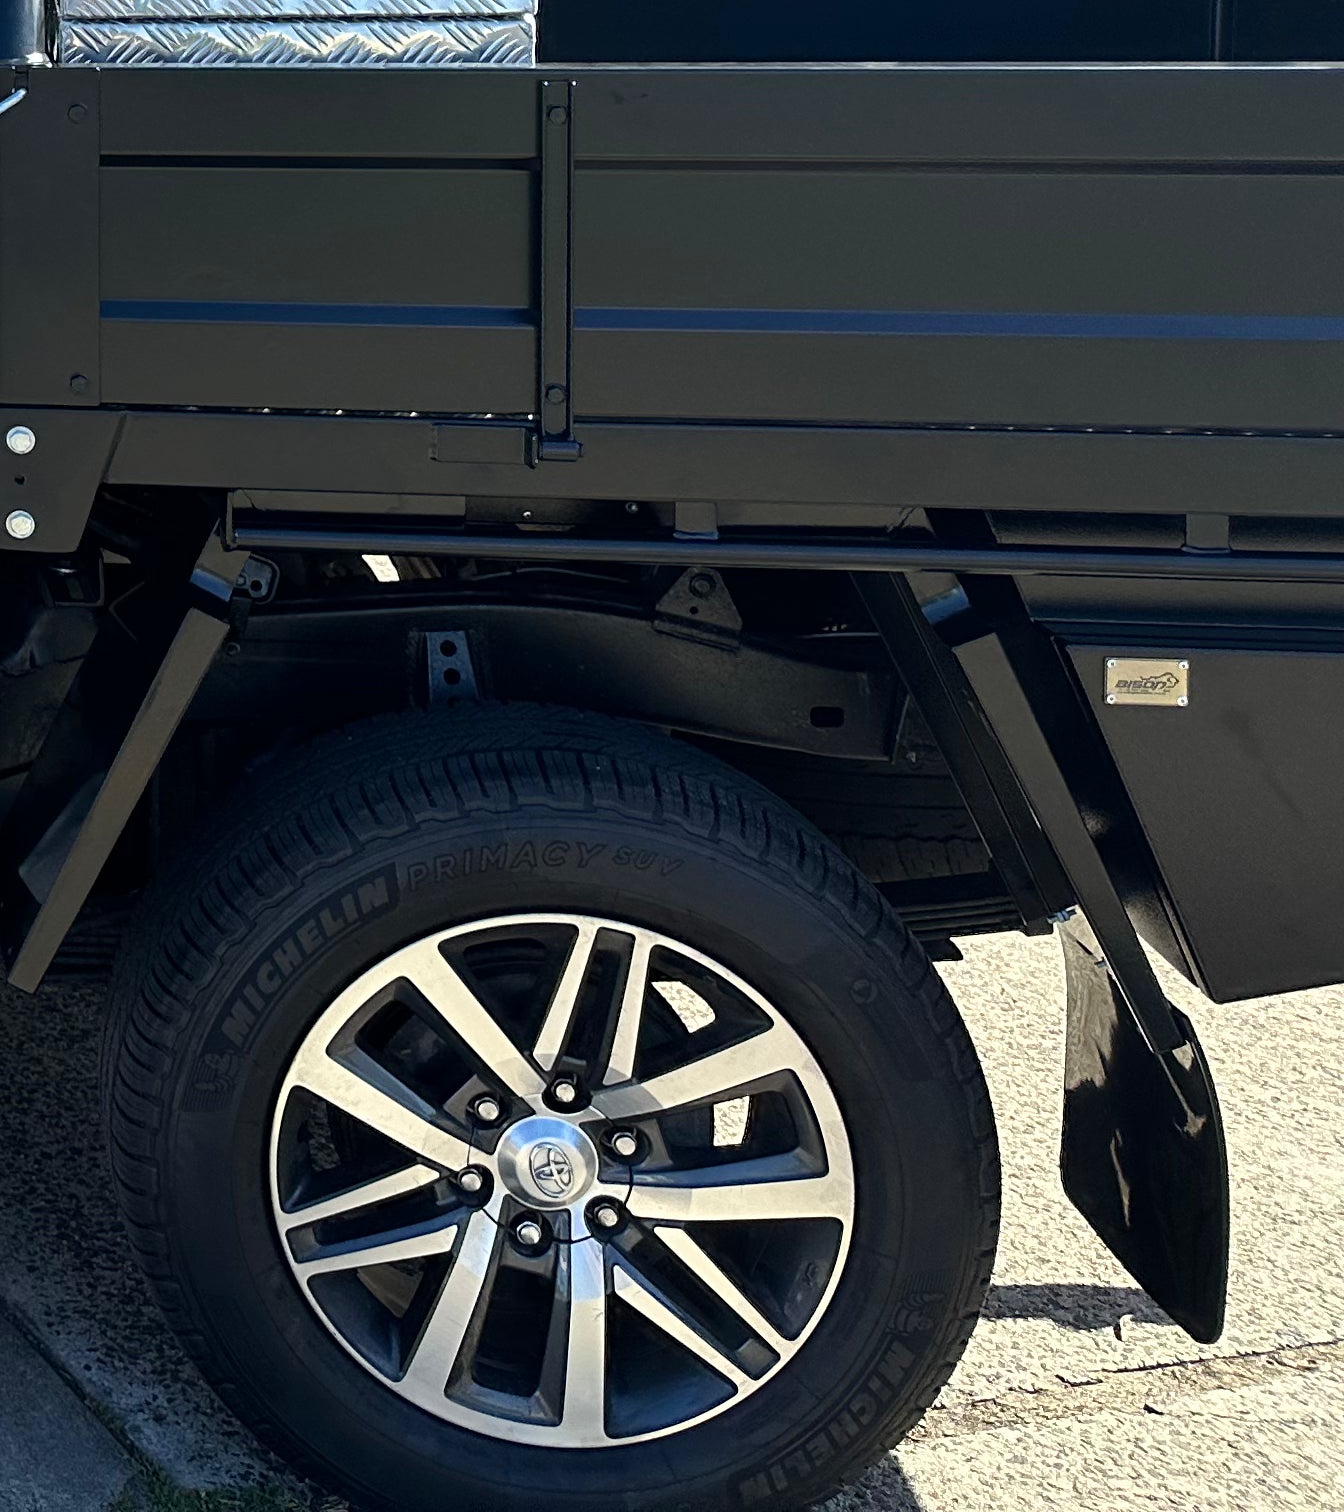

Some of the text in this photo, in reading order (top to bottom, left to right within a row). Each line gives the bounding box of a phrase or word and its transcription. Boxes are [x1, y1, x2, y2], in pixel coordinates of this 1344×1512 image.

[220, 840, 686, 1047] MICHELIN PRIMACY SUV
[738, 1339, 917, 1504] MICHELIN
